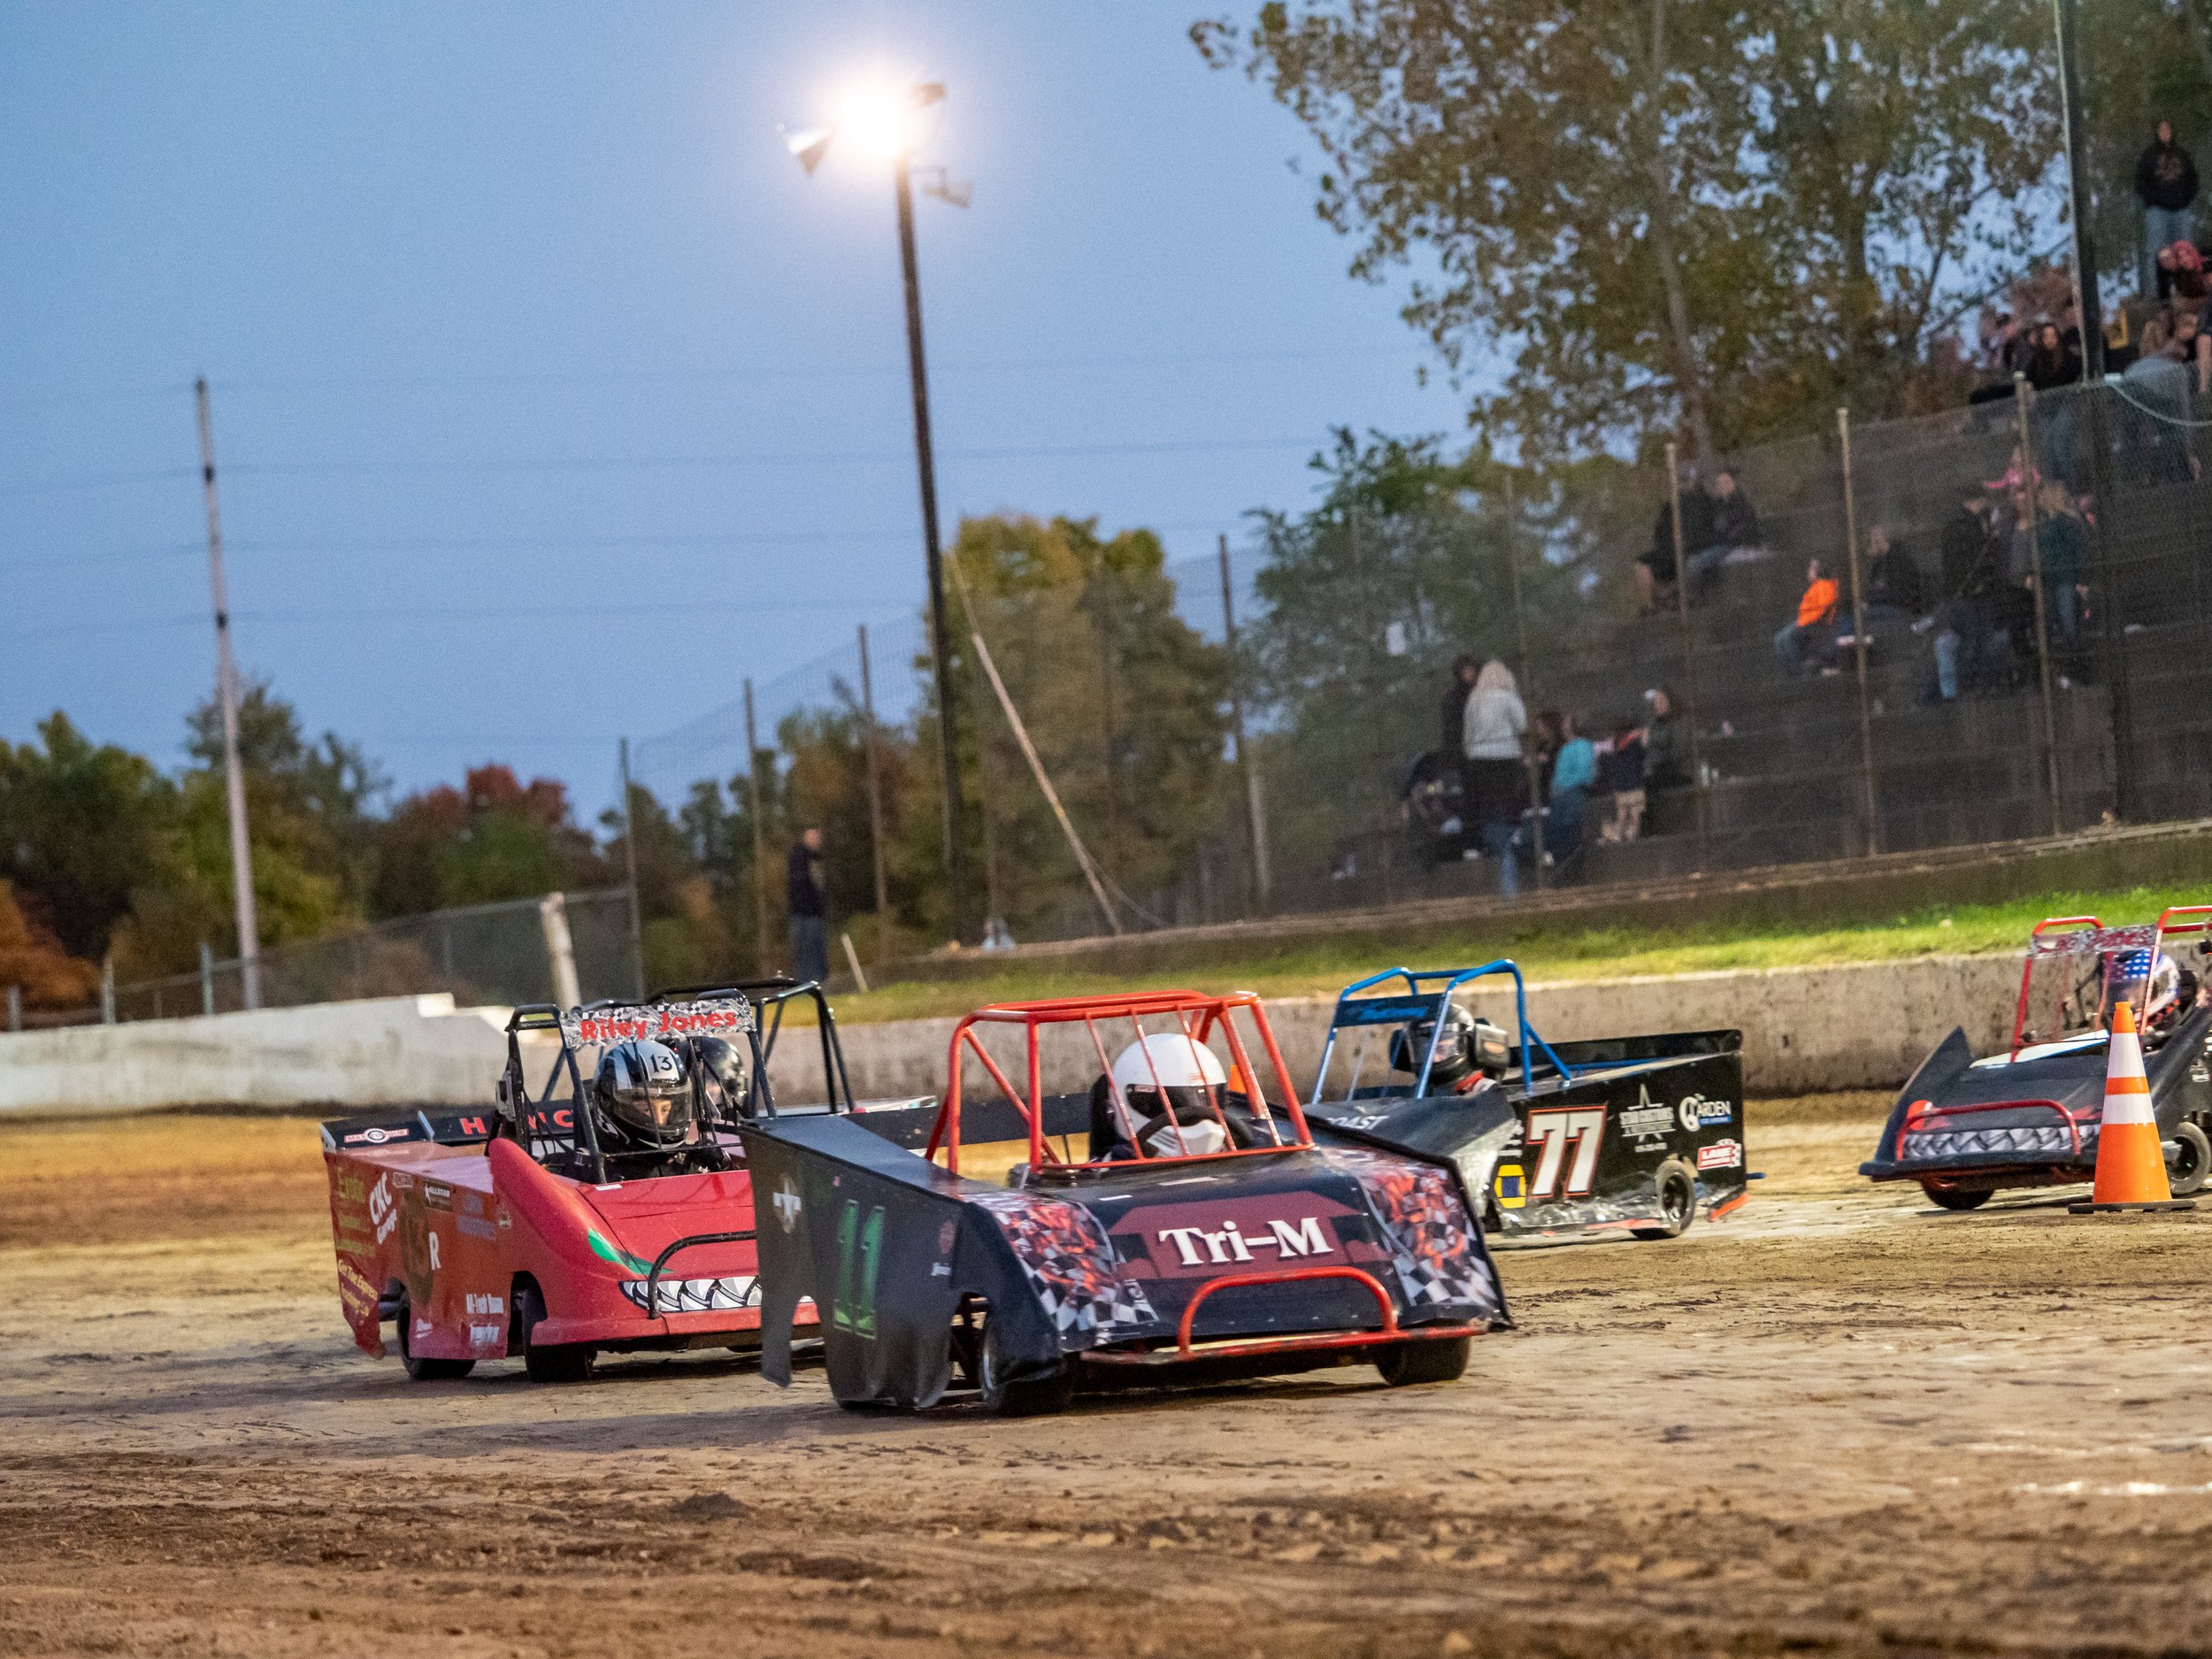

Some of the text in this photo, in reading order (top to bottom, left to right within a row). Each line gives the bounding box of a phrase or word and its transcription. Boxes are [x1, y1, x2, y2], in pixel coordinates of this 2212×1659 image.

[580, 1011, 737, 1041] Riley Jones
[650, 1054, 673, 1073] 13
[1526, 1105, 1607, 1199] 77
[428, 1231, 442, 1271] R
[1158, 1217, 1334, 1264] Tri-M
